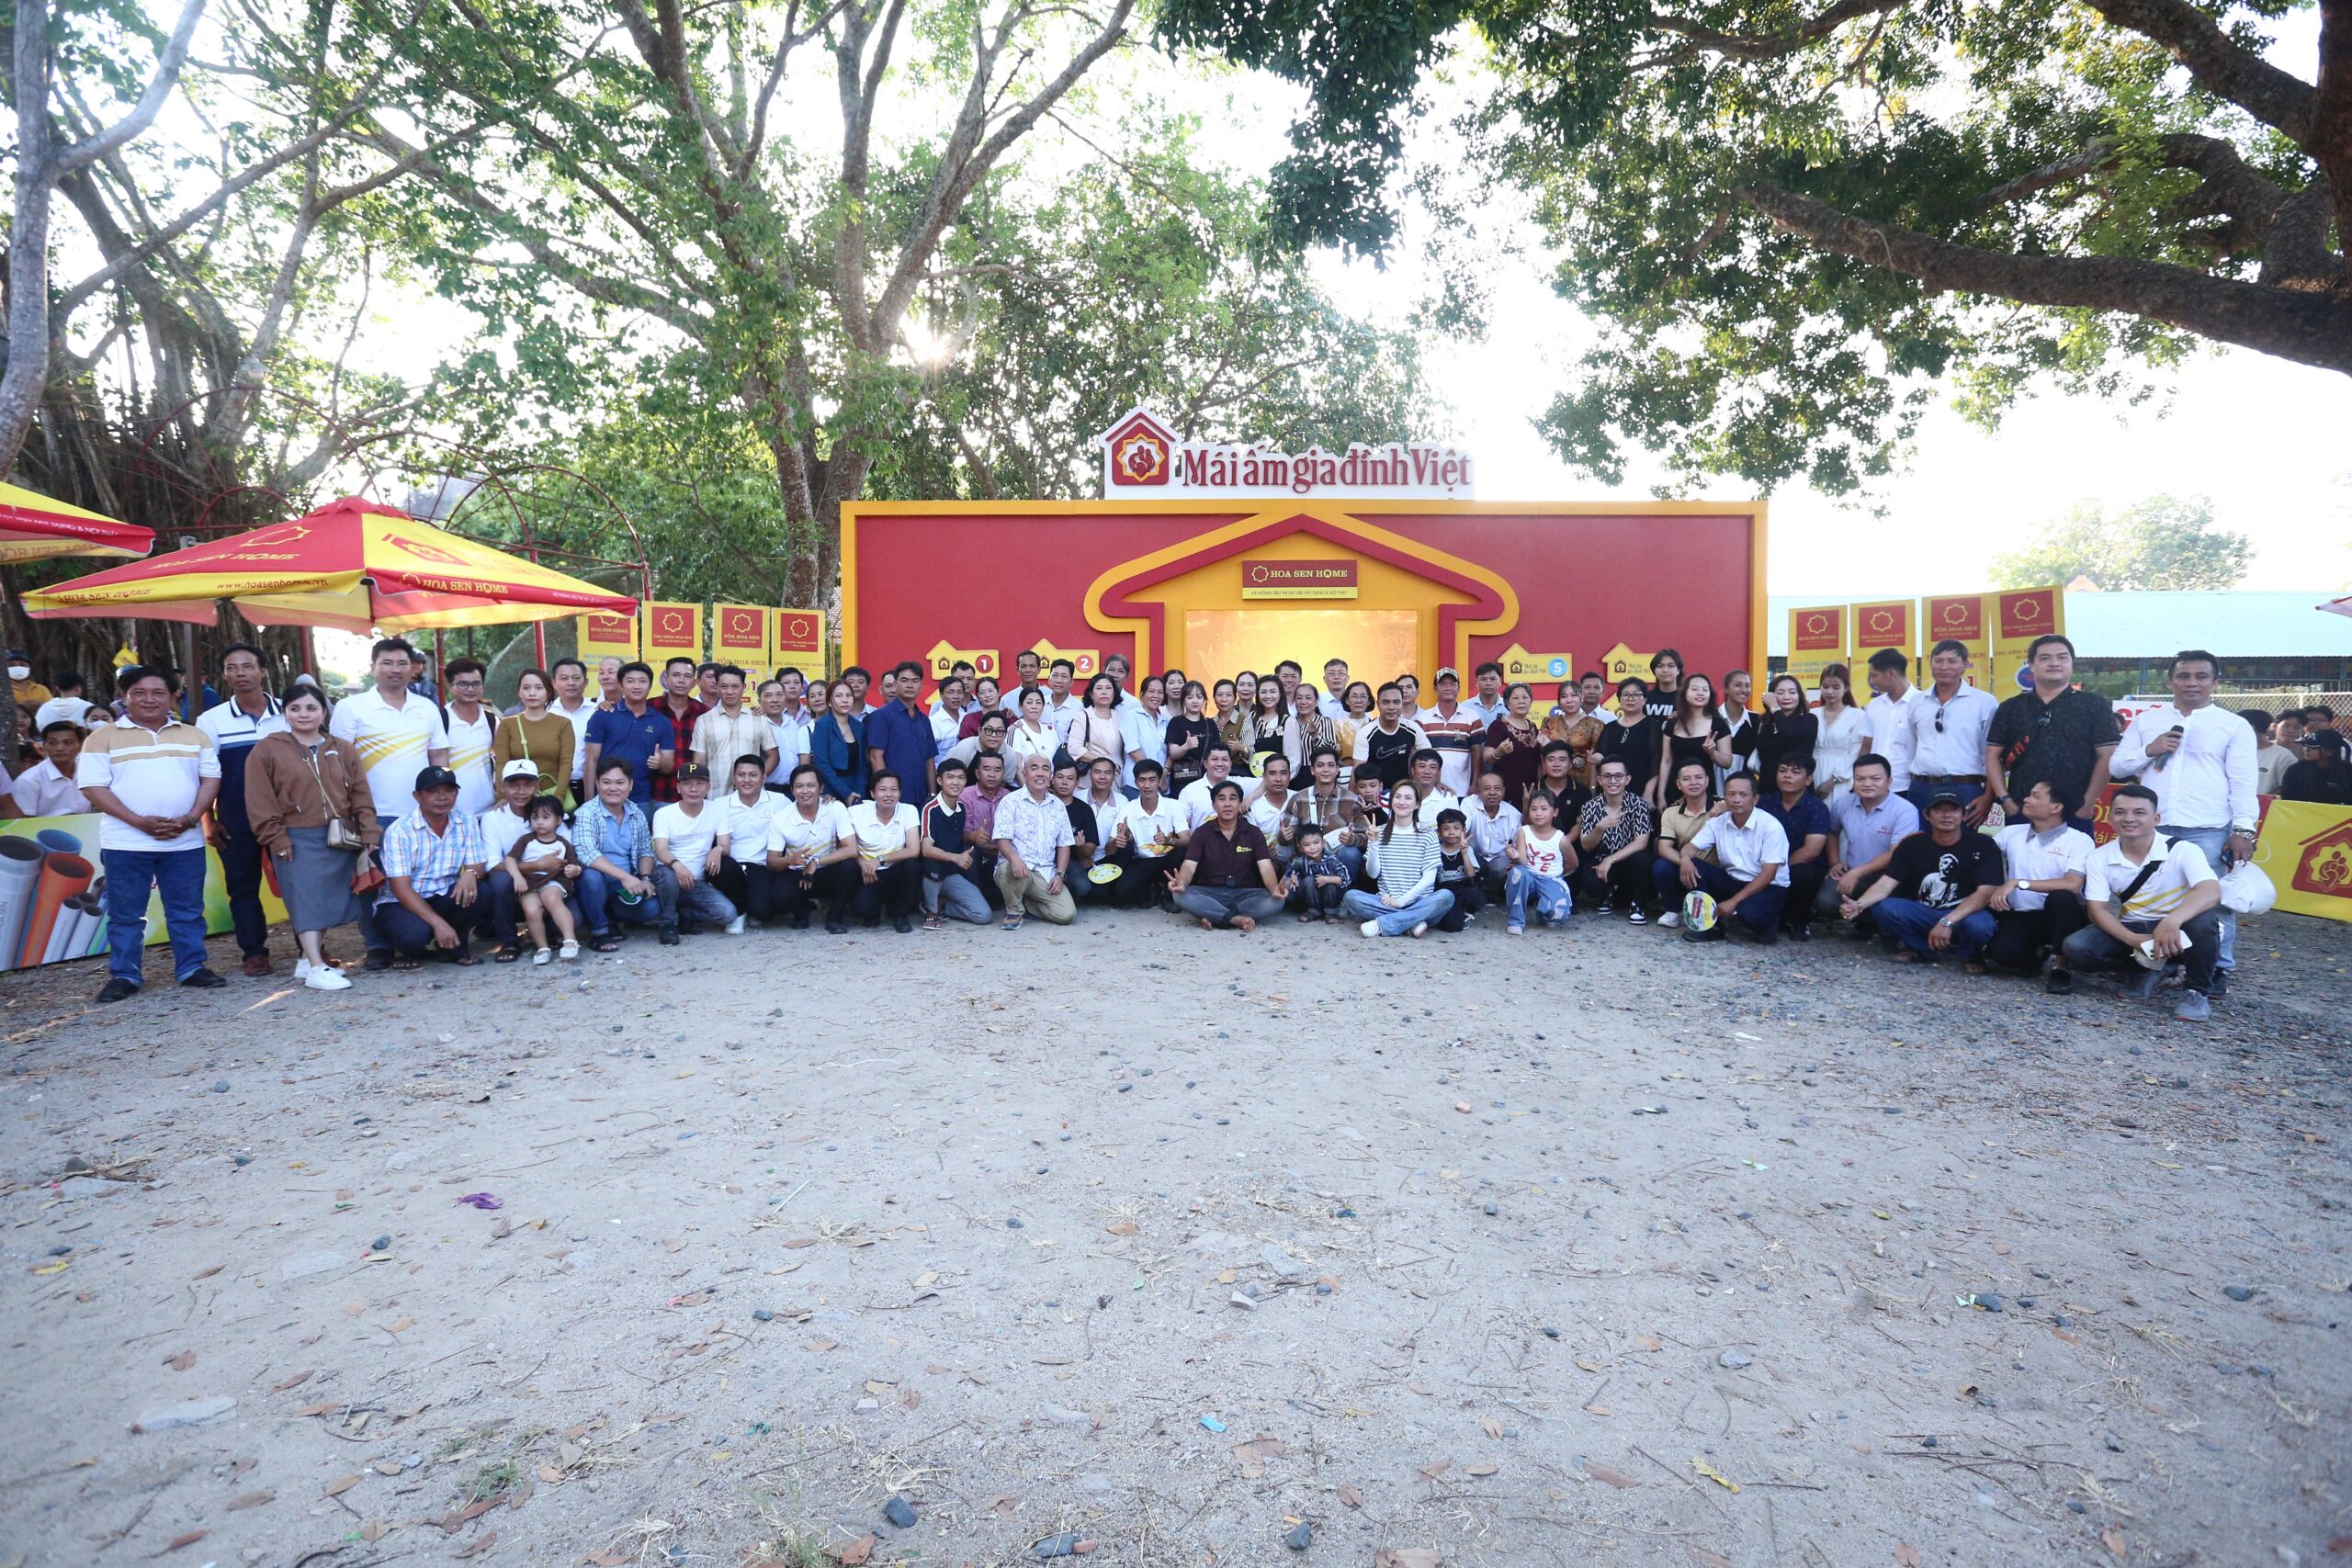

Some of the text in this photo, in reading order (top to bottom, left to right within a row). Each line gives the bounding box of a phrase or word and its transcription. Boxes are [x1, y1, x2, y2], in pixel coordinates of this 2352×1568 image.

[1182, 445, 1472, 494] Mái ấm gia đình Việt
[1270, 569, 1348, 579] HOA SEN HOME
[422, 580, 509, 594] HOA SEN HOME
[980, 659, 988, 671] 1
[1080, 658, 1090, 669] 2
[1553, 661, 1562, 673] 5
[689, 763, 697, 773] P
